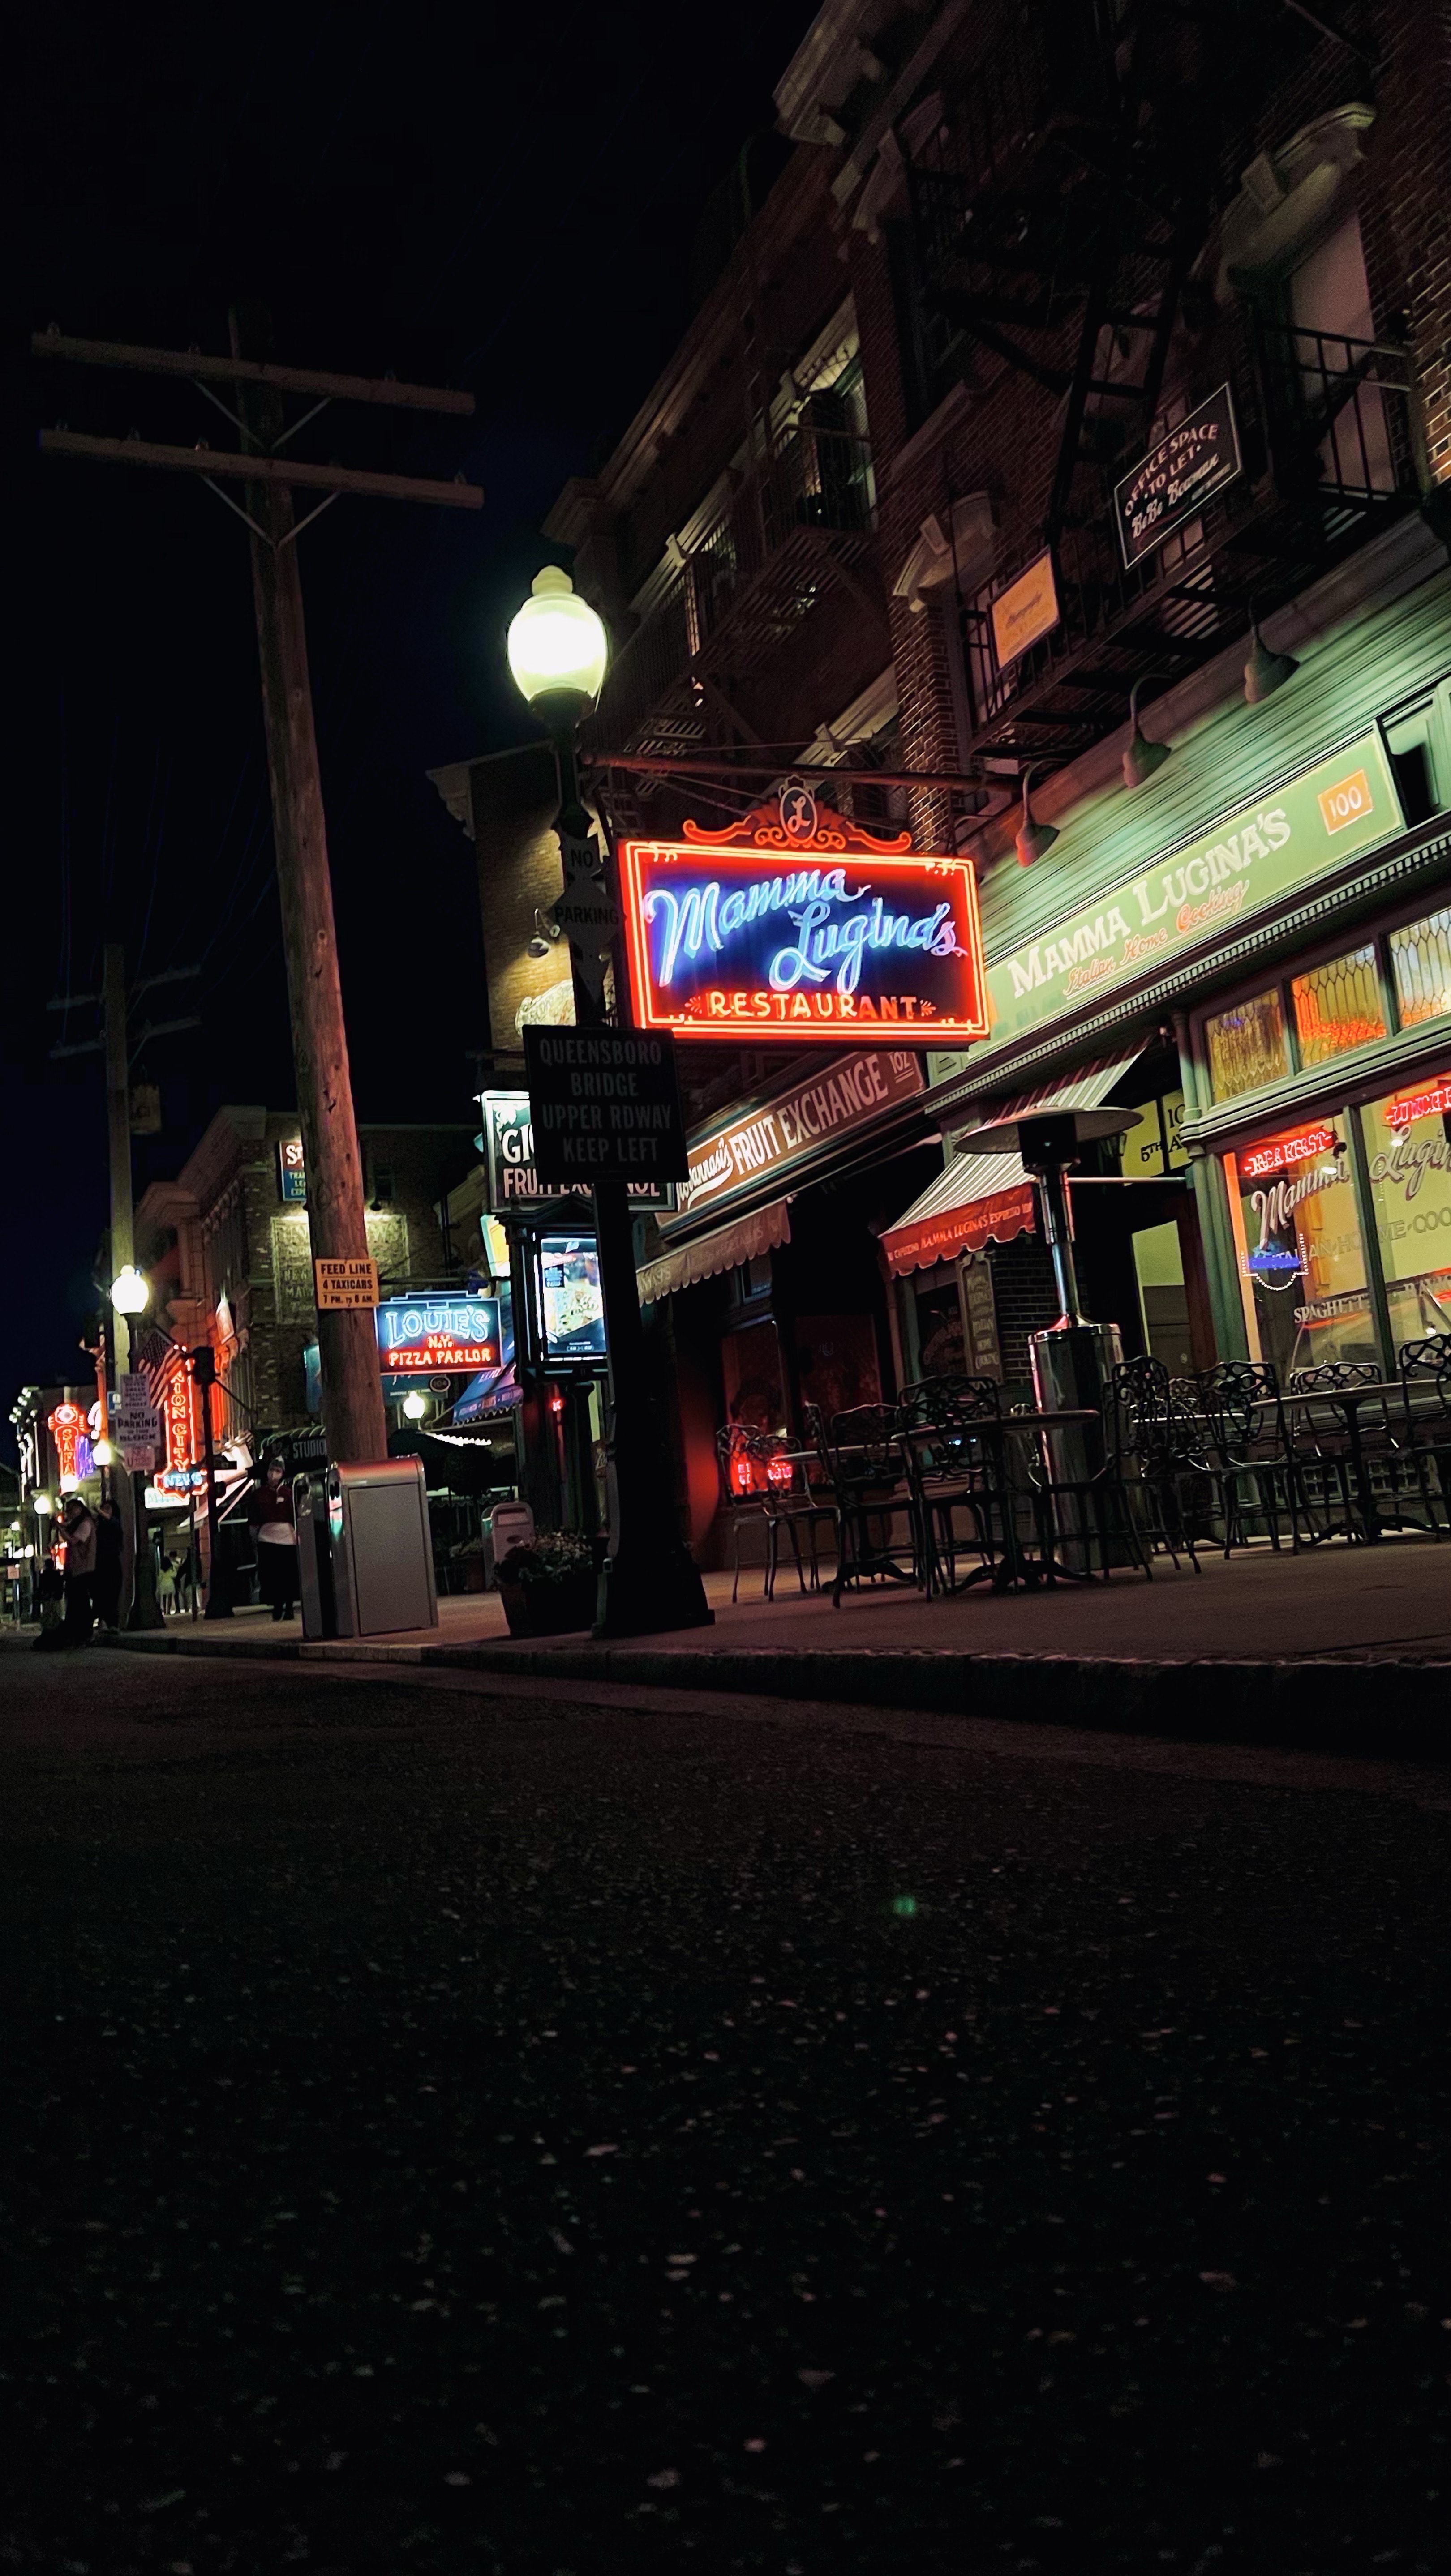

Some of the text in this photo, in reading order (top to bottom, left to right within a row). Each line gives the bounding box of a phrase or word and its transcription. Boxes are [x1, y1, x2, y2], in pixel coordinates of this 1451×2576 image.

[1125, 449, 1168, 517] OFFICE
[1169, 423, 1219, 454] SPACE
[1328, 785, 1362, 822] 100
[571, 849, 594, 868] NO
[554, 906, 619, 925] PARKING
[1007, 807, 1292, 999] MAMMA LUGINA'S
[643, 868, 872, 988] Mamma
[1063, 879, 1249, 996] Italian Home Cooking
[706, 991, 918, 1022] RESTAURANT
[539, 1037, 662, 1067] QUEENSBORO
[889, 1051, 911, 1074] 102
[570, 1071, 640, 1097] BRIDGE
[541, 1103, 672, 1130] UPPER RDWAY
[728, 1113, 781, 1176] FRUIT
[776, 1053, 889, 1149] EXCHANGE
[562, 1136, 659, 1163] KEEP LEFT
[1140, 1141, 1163, 1162] 5TH
[321, 1263, 372, 1275] FEED LINE
[323, 1279, 373, 1289] 4 TAXICABS
[385, 1304, 490, 1349] LOUIE'S
[427, 1334, 455, 1348] N.Y.
[389, 1347, 492, 1367] PIZZA PARLOR
[118, 1416, 157, 1428] PARKING
[170, 1370, 189, 1472] NION CITY
[163, 1471, 202, 1488] NEWS
